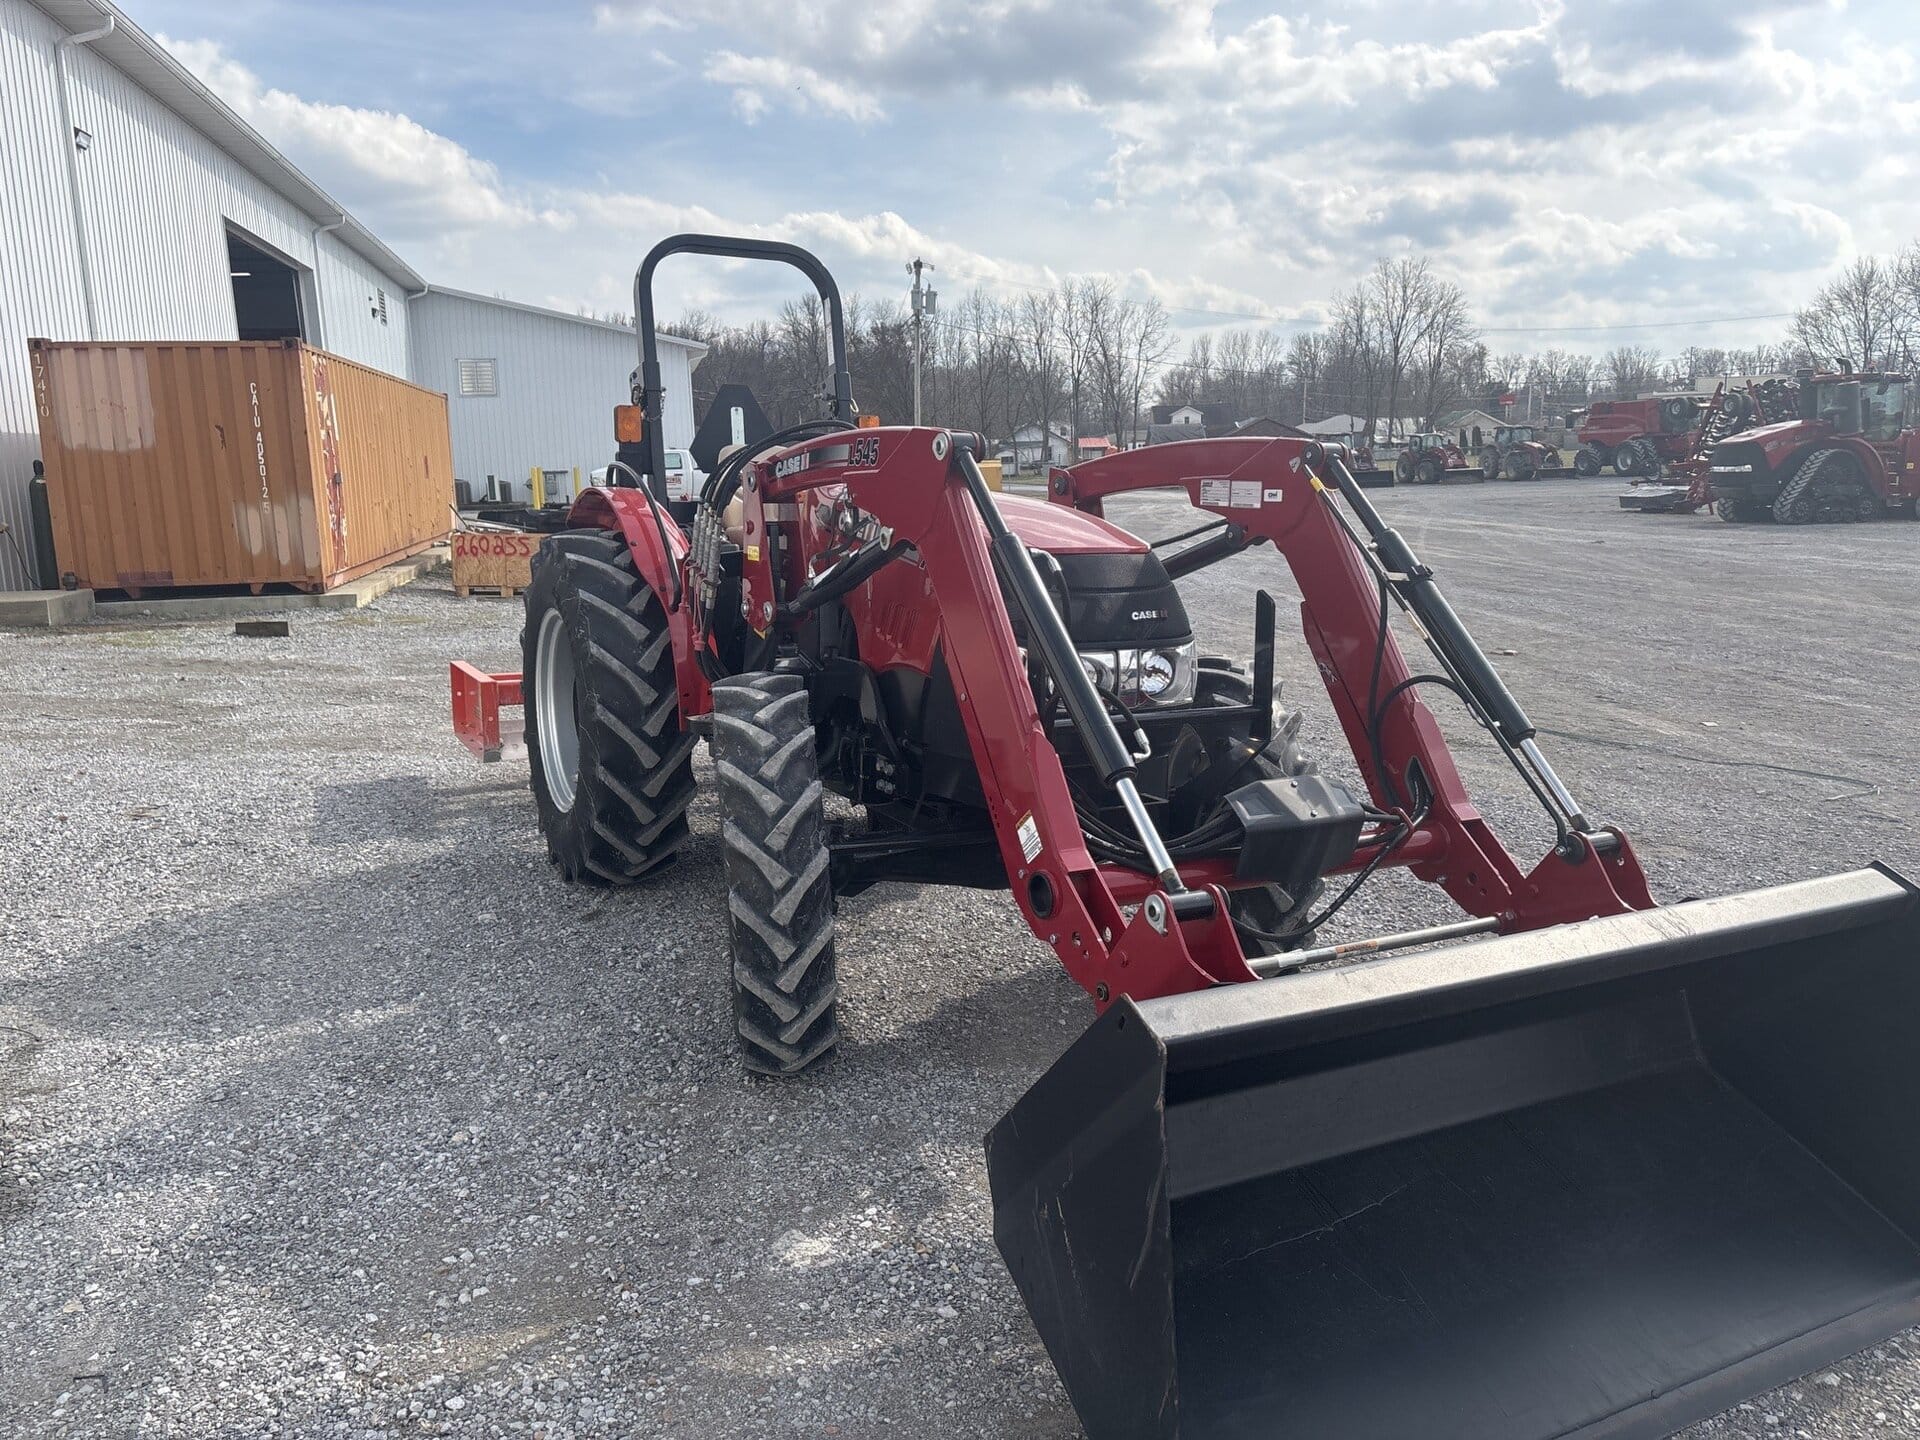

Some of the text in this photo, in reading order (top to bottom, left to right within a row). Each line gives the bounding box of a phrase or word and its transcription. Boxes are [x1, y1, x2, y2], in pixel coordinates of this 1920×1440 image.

[34, 353, 49, 417] 17410
[250, 382, 261, 428] CAIU
[848, 438, 880, 467] L545
[775, 455, 801, 478] CASE
[456, 535, 531, 557] 260255
[1131, 610, 1159, 621] CASE
